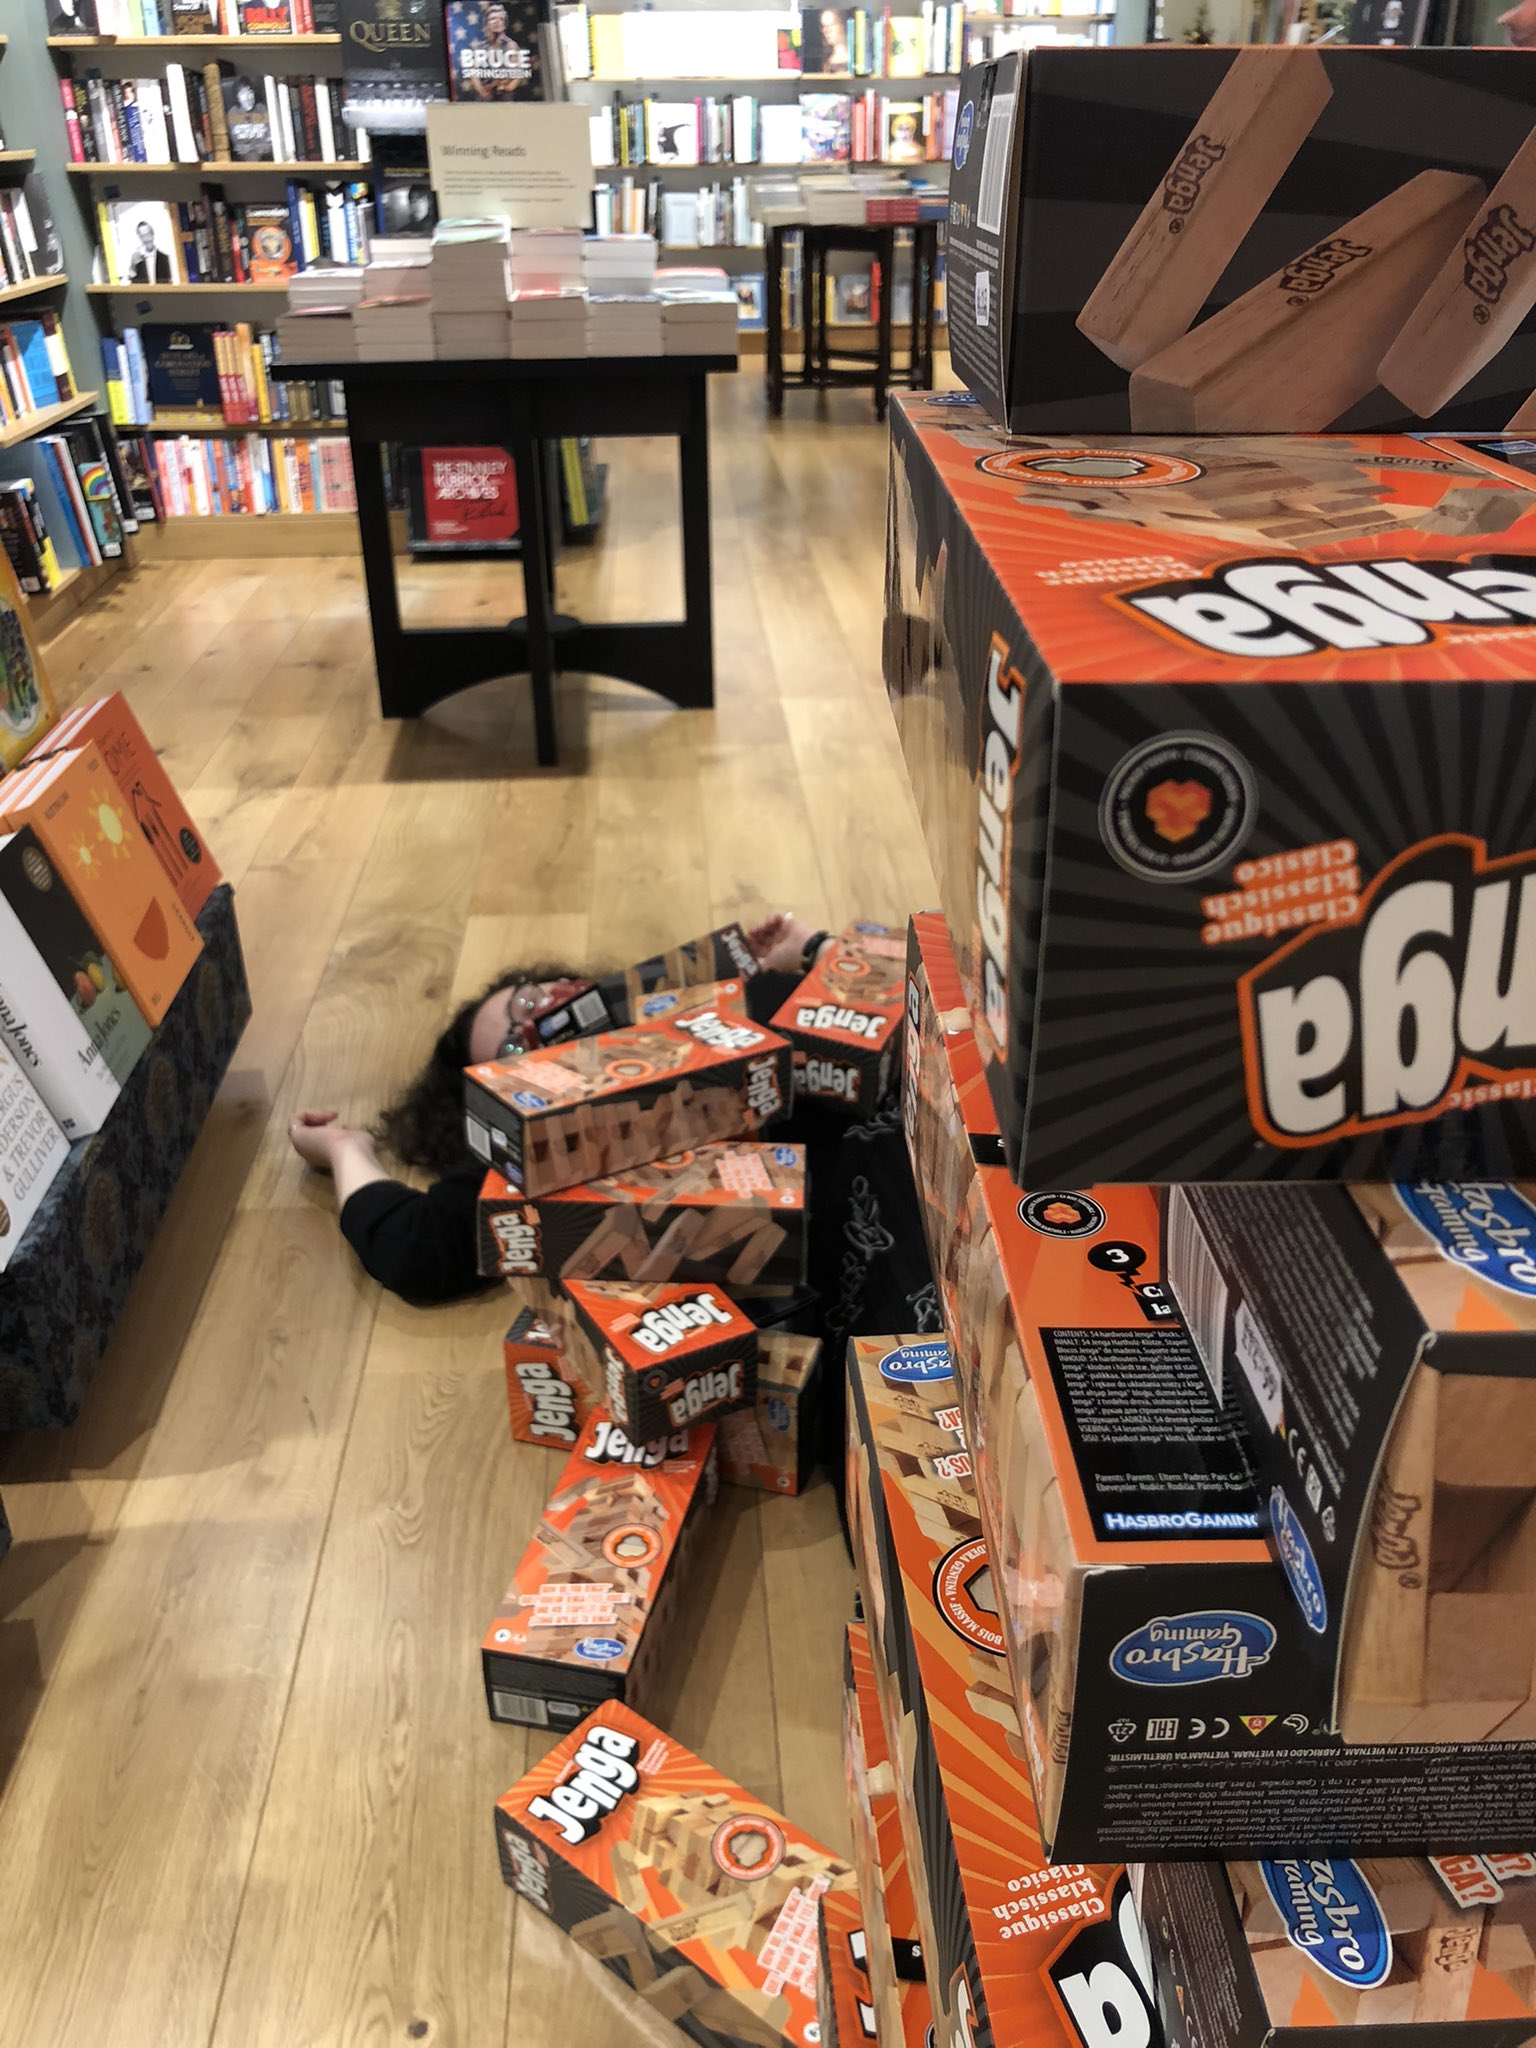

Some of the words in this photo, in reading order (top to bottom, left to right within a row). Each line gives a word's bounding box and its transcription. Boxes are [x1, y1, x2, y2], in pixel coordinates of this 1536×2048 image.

[350, 20, 432, 52] QUEEN
[460, 50, 531, 68] BRUCE
[461, 69, 533, 80] SPRINGSTEEN
[441, 144, 488, 159] Winning
[491, 144, 528, 157] Reads
[1162, 134, 1226, 213] Jenga
[1279, 238, 1373, 296] Jenga
[1464, 204, 1536, 302] Jenga
[434, 475, 489, 488] KUBRICK
[1128, 560, 1536, 657] enga
[981, 649, 1020, 1046] Jenga
[1233, 840, 1355, 883] Clásico
[1204, 864, 1359, 916] klassisch
[1203, 895, 1358, 942] Classique
[1258, 872, 1536, 1134] nga
[674, 1011, 767, 1049] Jenga
[796, 1004, 887, 1039] Jenga
[78, 1039, 106, 1074] Anna
[746, 1055, 784, 1117] Jenga
[793, 1059, 859, 1099] Jenga
[1449, 1078, 1536, 1108] lassic
[0, 1093, 35, 1154] DERSON
[10, 1110, 48, 1169] TREVOR
[13, 1126, 60, 1201] GULLIVER
[492, 1213, 538, 1272] Jenga
[1106, 1249, 1129, 1263] 3
[631, 1293, 733, 1353] Jenga
[889, 1356, 951, 1374] asbro
[900, 1346, 948, 1359] aming
[515, 1362, 577, 1443] Jenga
[670, 1363, 744, 1425] Jenga
[945, 1560, 966, 1596] GENUINA
[949, 1603, 980, 1632] MASSIF
[1149, 1622, 1242, 1648] Gaming
[977, 1628, 1003, 1645] BOIS
[1125, 1640, 1264, 1674] Hasbro
[1175, 1751, 1229, 1759] VIETNAM'DA
[1232, 1750, 1274, 1758] VIETNAM.
[1276, 1749, 1289, 1757] EN
[1290, 1749, 1341, 1757] FABRICADO
[1343, 1748, 1385, 1756] VIETNAM.
[1387, 1747, 1397, 1755] IN
[1399, 1745, 1458, 1754] HERGESTELLT
[1461, 1744, 1502, 1752] VIETNAM.
[1504, 1743, 1518, 1751] AU
[527, 1725, 639, 1845] Jenga
[503, 1830, 554, 1914] Jenga
[1007, 1864, 1085, 1892] Clásico
[991, 1877, 1098, 1921] klassisch
[1274, 1859, 1324, 1946] aming
[1301, 1858, 1366, 1972] asbro
[999, 1896, 1106, 1940] Classique
